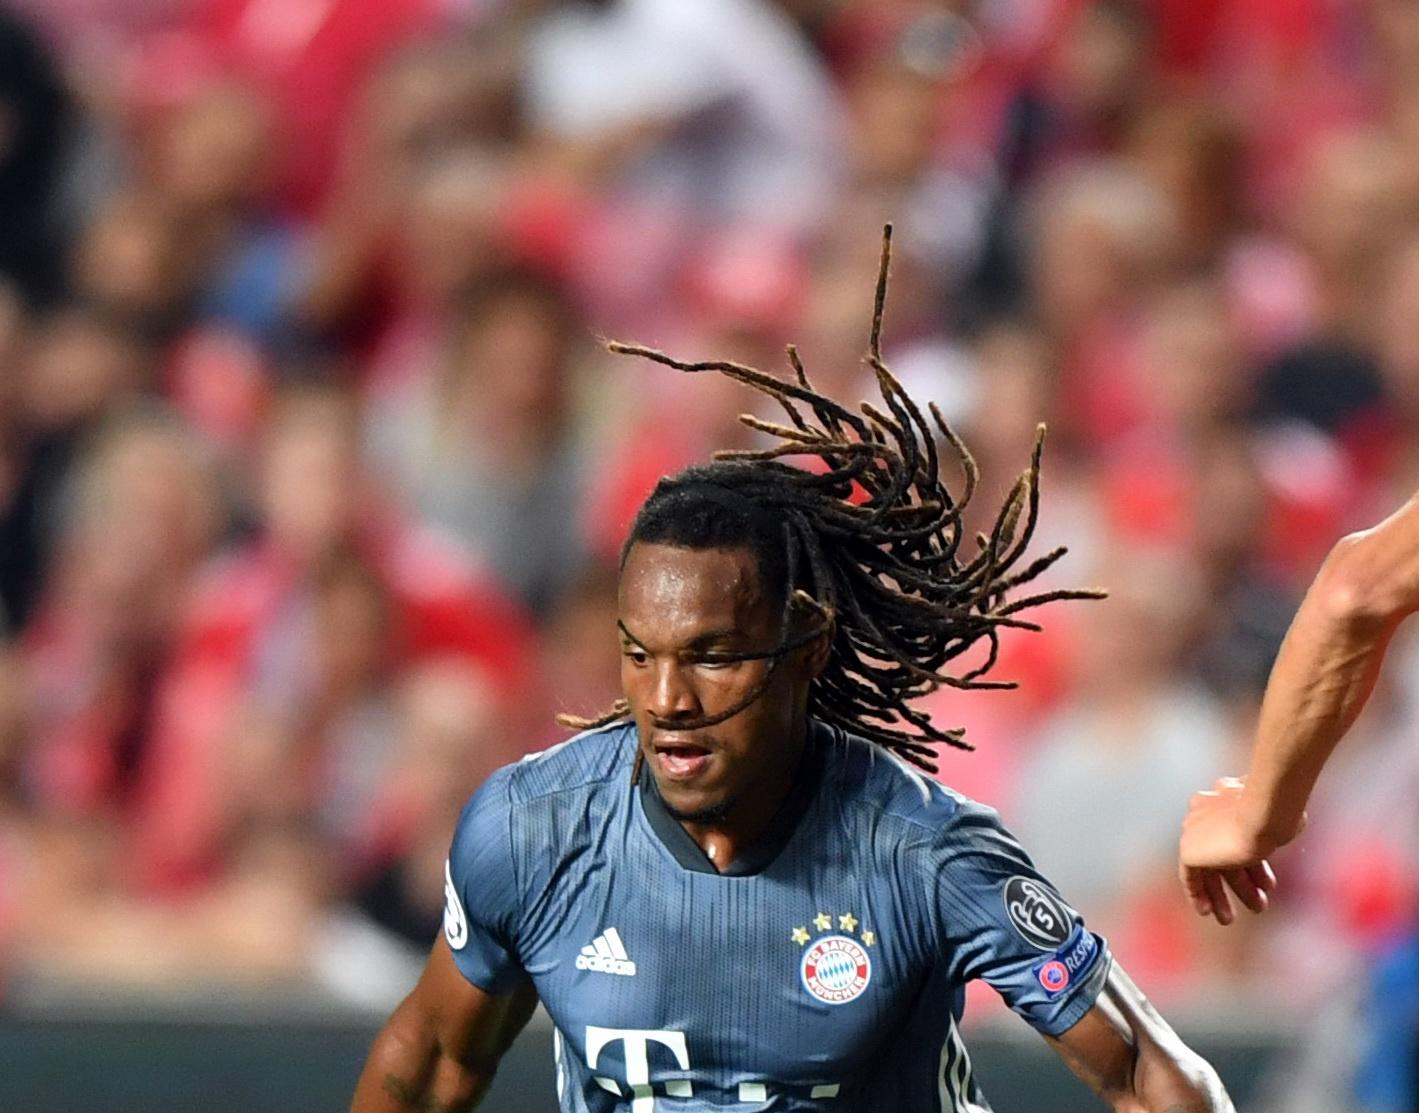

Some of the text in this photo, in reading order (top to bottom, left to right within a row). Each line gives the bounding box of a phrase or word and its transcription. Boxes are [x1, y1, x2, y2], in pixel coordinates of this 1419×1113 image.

[1035, 906, 1054, 930] 5
[820, 940, 867, 966] BAYERN
[575, 954, 637, 977] adidas
